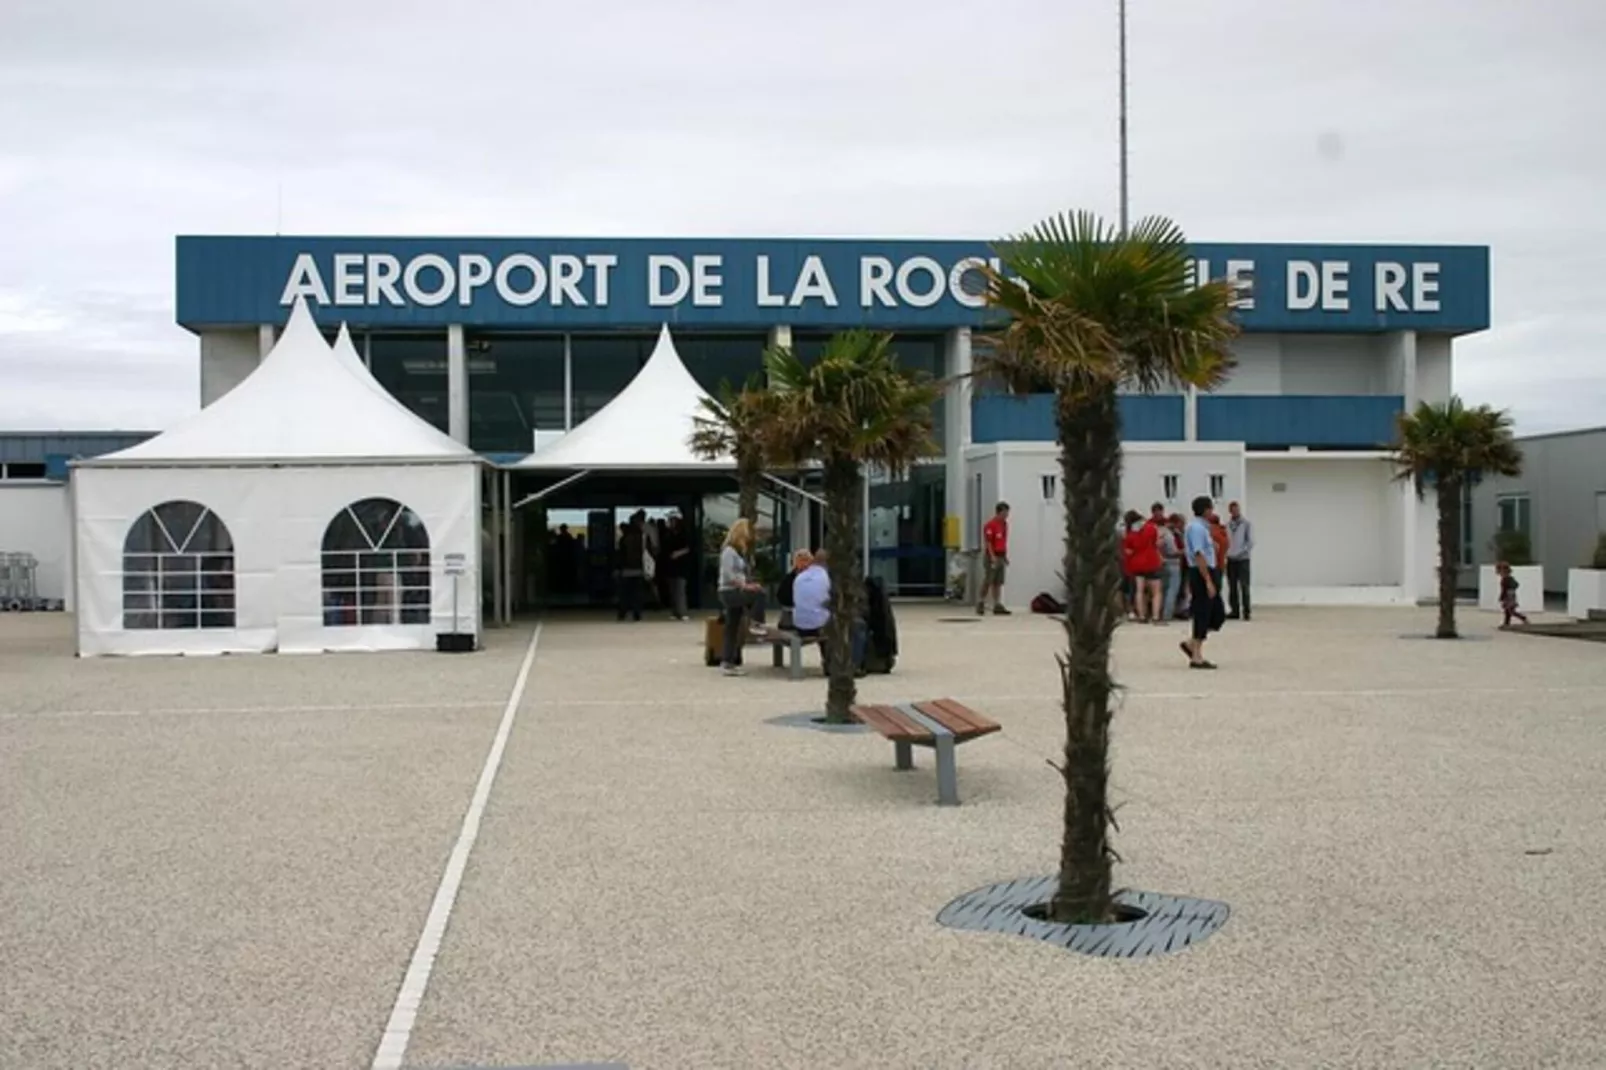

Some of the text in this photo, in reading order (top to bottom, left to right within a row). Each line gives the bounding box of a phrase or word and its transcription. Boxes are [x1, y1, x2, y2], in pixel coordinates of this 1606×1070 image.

[279, 253, 617, 308] AEROPORT
[647, 255, 723, 307] DE
[756, 255, 839, 307] LA
[1286, 260, 1350, 311] DE
[1374, 261, 1441, 312] RE
